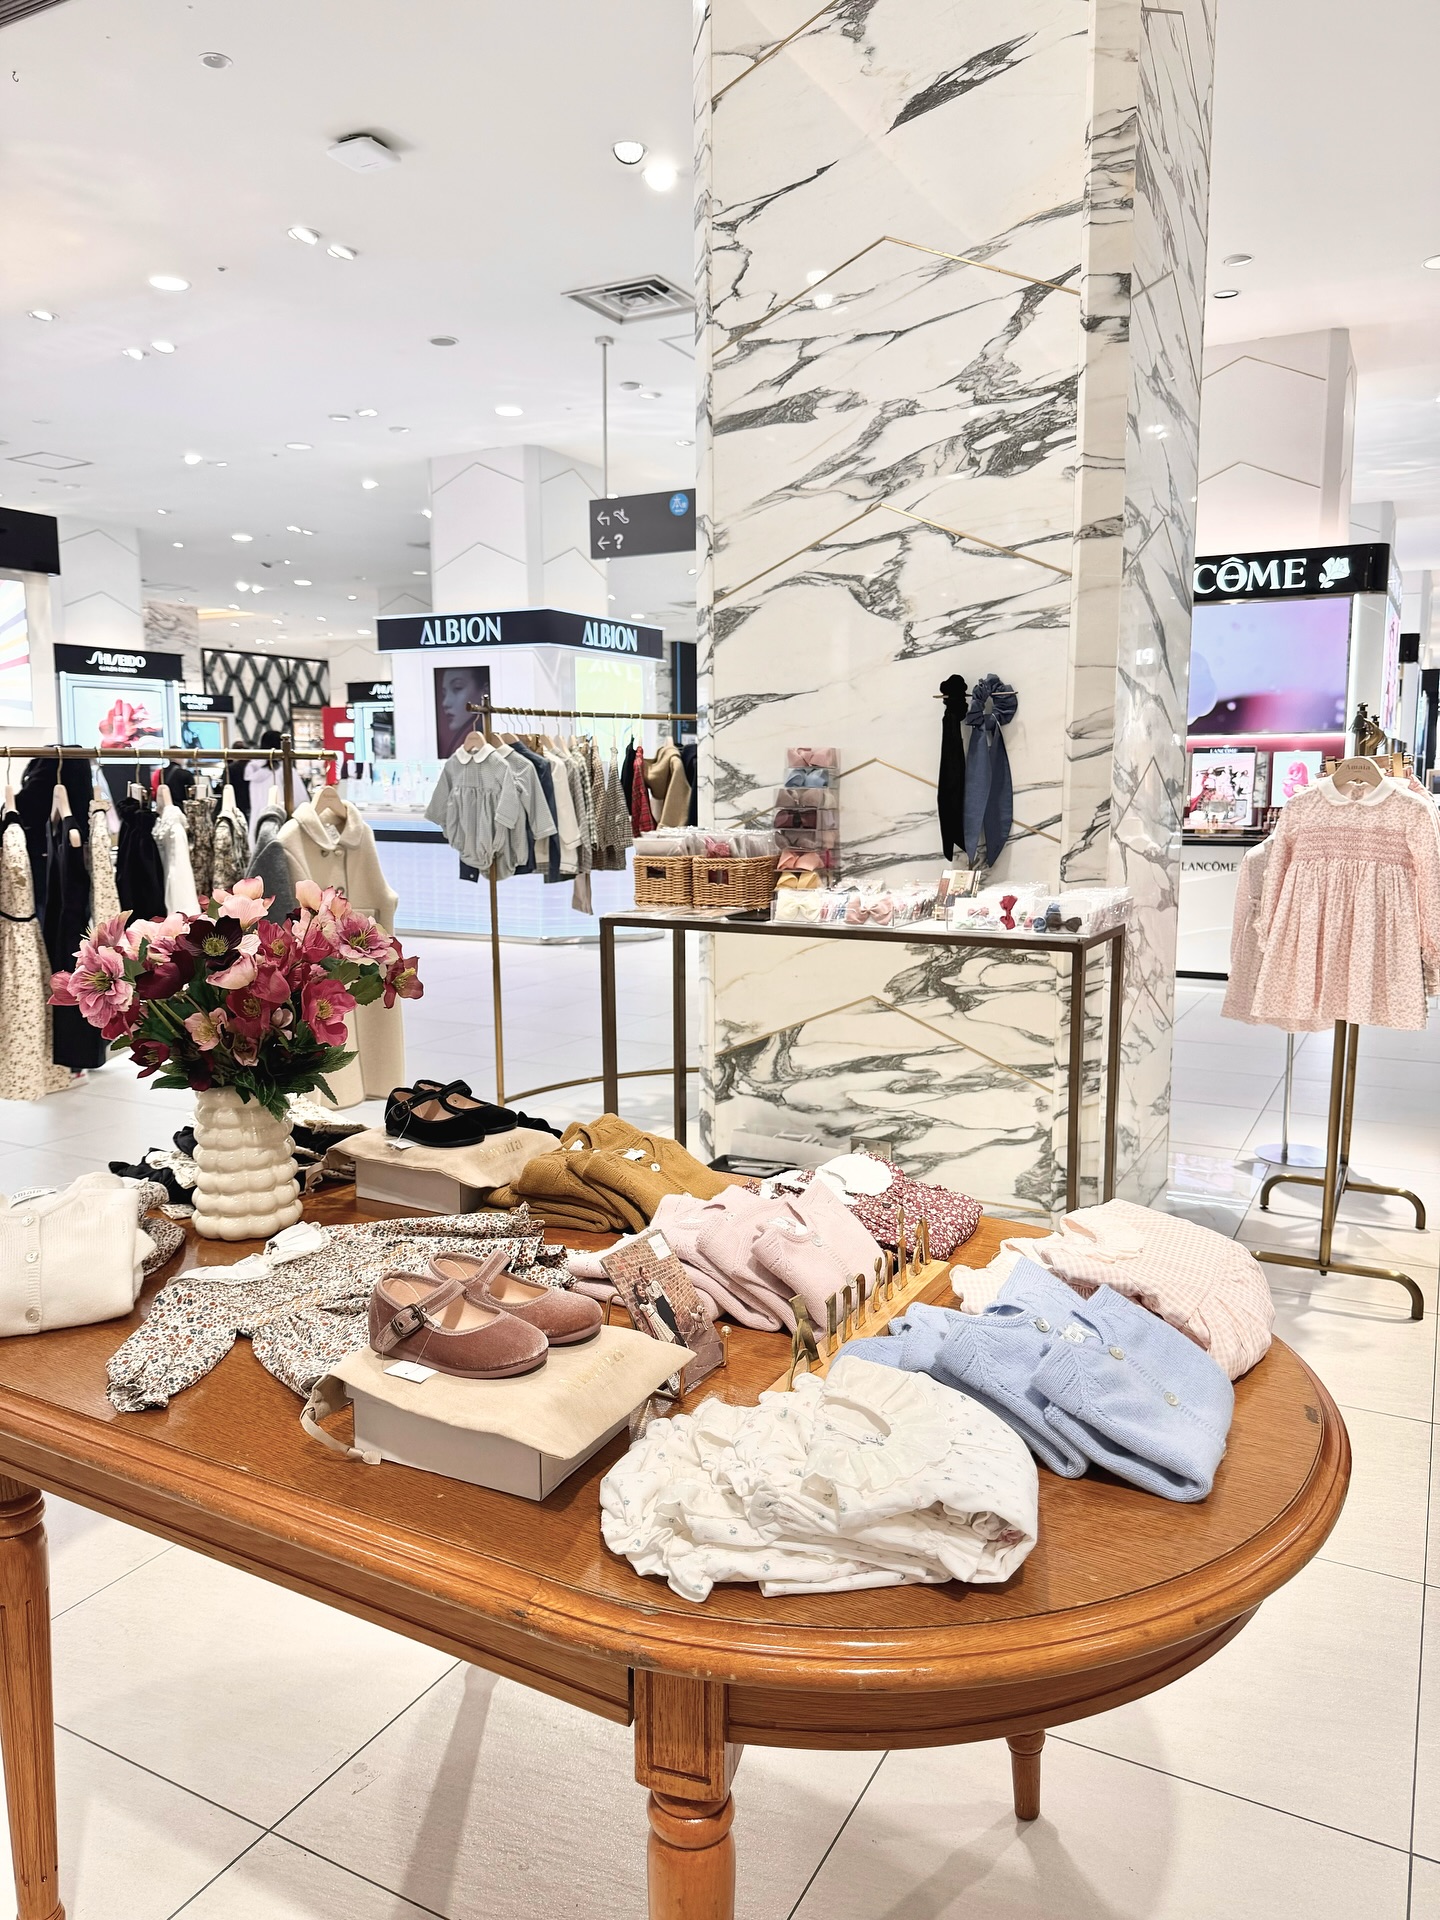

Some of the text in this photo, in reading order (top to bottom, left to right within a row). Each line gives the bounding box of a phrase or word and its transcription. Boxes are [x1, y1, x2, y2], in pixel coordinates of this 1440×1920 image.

[1192, 556, 1307, 594] CÔME
[420, 616, 502, 645] ALBION
[582, 621, 638, 652] ALBION
[86, 650, 147, 668] SHISEIDO
[1181, 861, 1238, 872] LANCÔME
